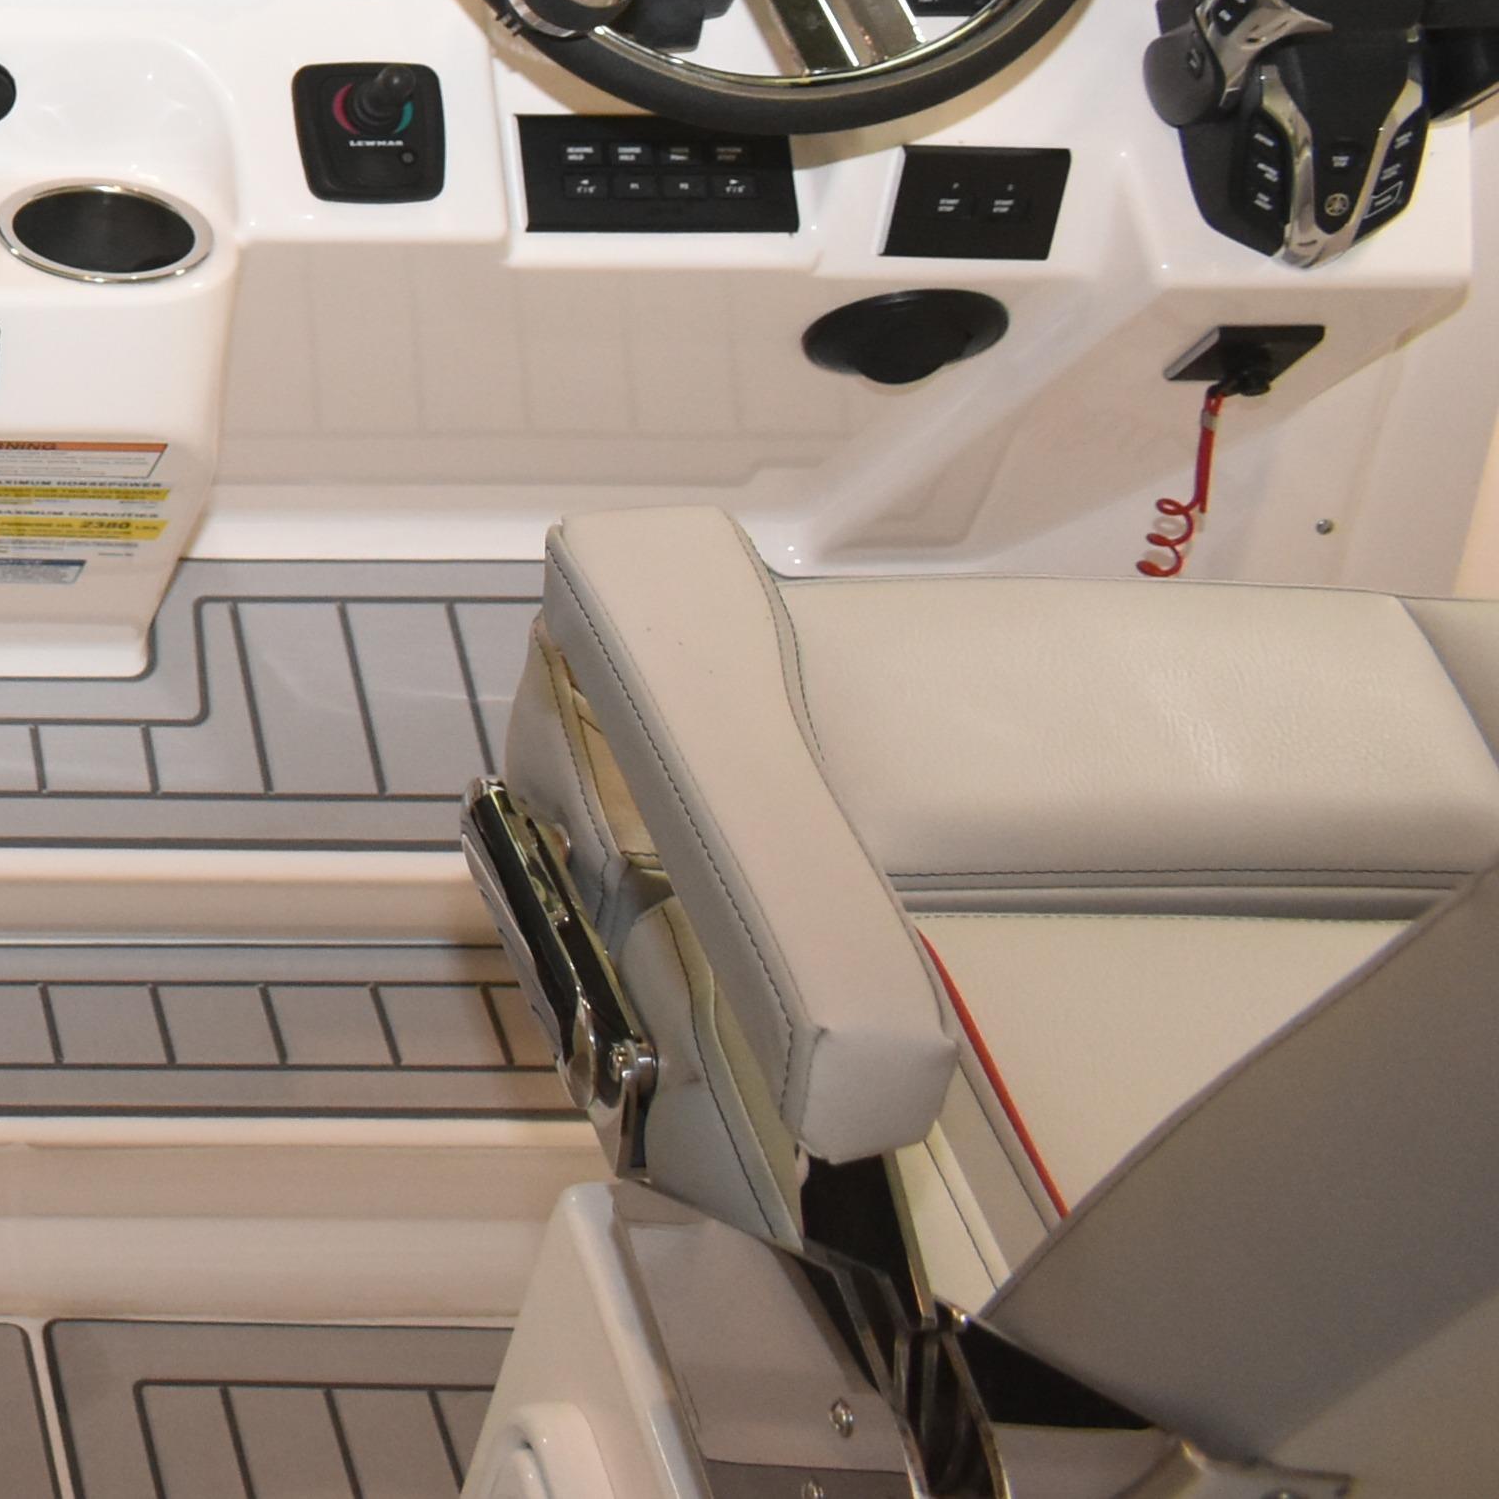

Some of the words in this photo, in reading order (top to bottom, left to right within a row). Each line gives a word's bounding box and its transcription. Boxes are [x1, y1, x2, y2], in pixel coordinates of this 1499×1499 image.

[348, 139, 404, 147] LEWMAR
[56, 480, 163, 489] HORSEPOWER
[78, 520, 132, 531] 2380
